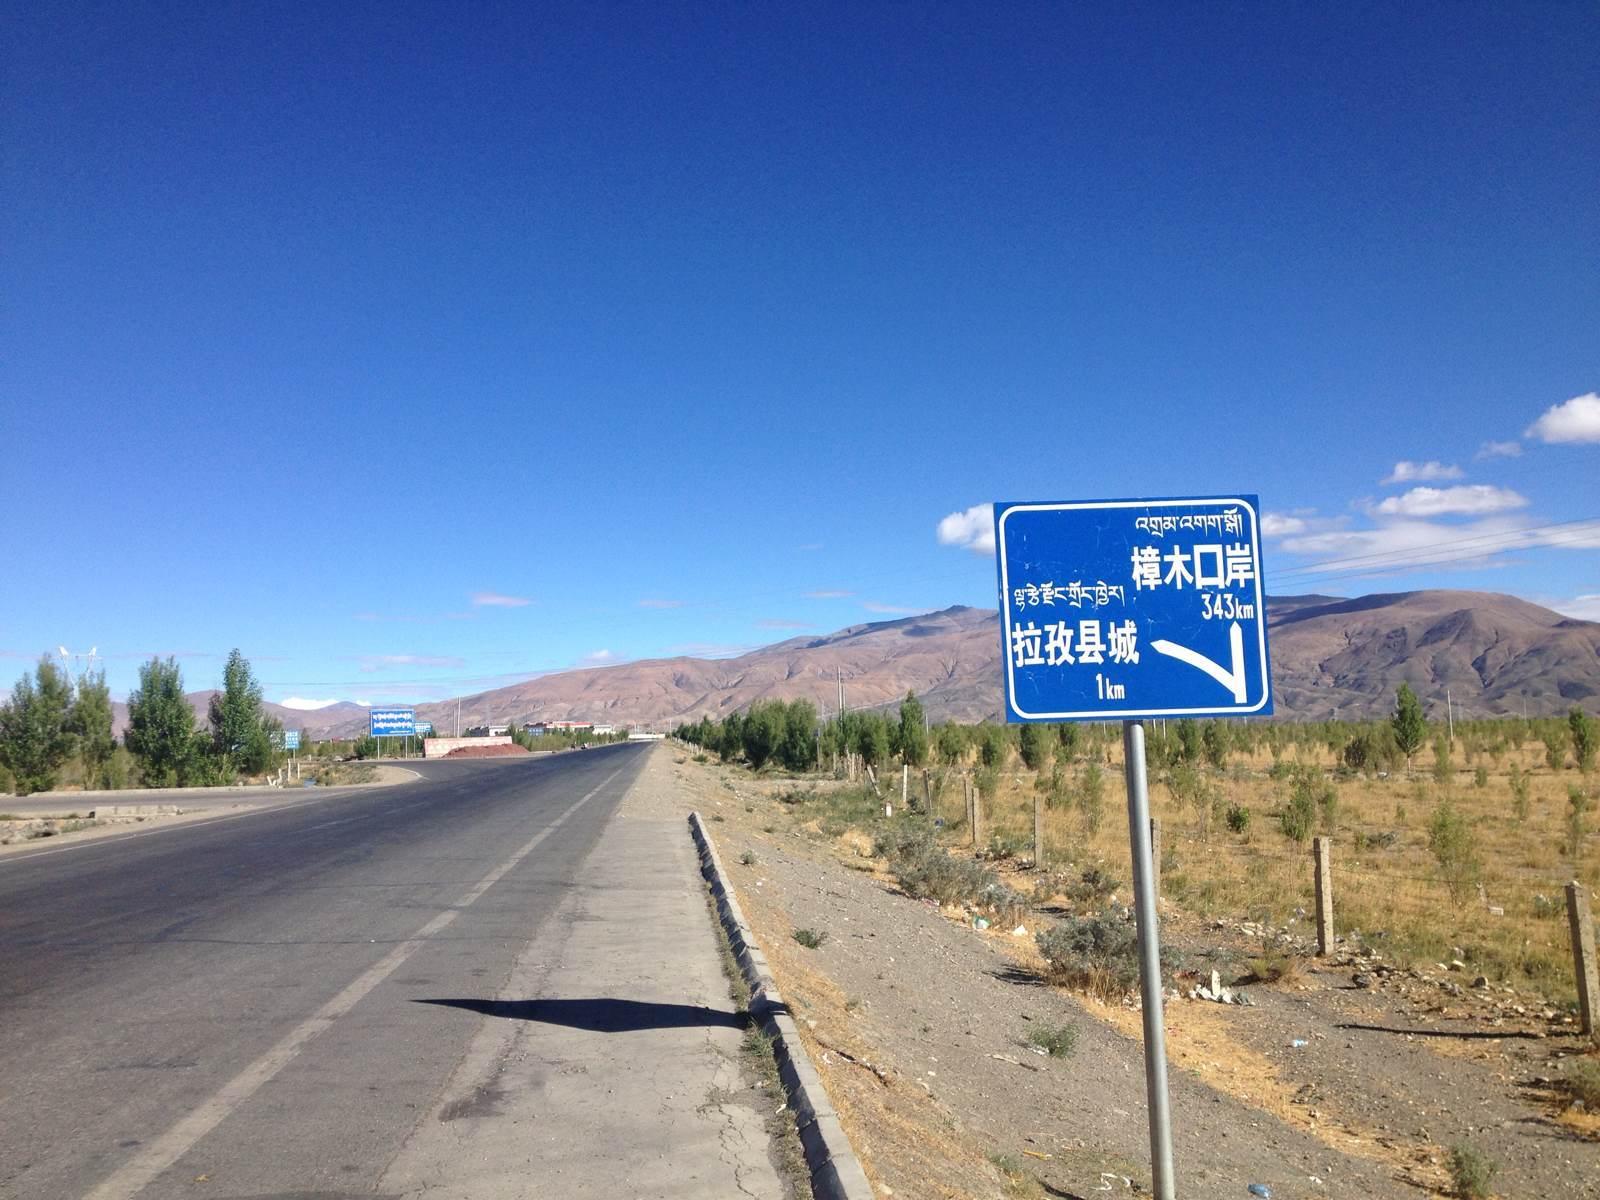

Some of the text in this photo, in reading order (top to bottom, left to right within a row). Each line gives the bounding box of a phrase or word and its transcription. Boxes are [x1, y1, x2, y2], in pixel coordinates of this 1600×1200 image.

[1131, 542, 1254, 591] 樟木口岸
[1202, 593, 1254, 620] 343km
[1012, 619, 1140, 668] 拉孜县城
